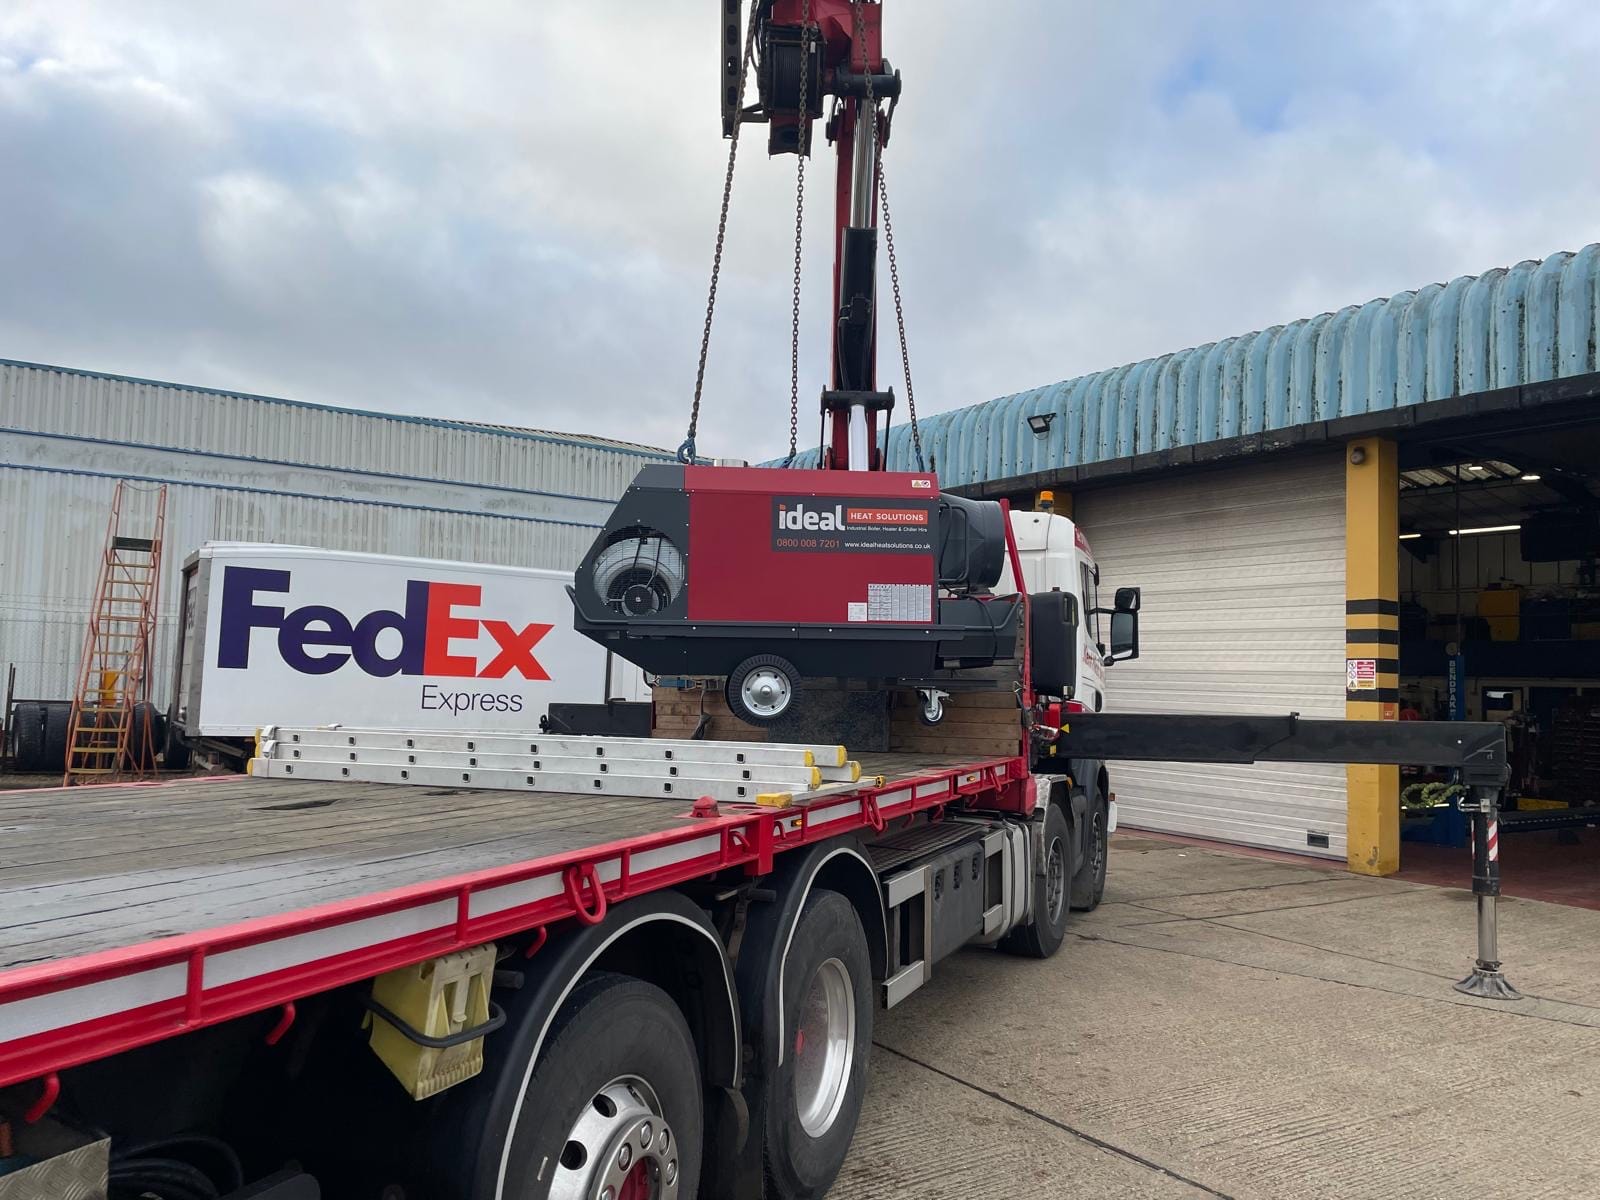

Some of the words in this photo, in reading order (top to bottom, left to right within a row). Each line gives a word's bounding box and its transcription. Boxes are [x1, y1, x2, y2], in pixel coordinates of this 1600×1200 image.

[779, 504, 845, 531] ideal
[876, 513, 924, 521] SOLUTIONS
[776, 538, 799, 548] 0800
[800, 539, 817, 548] 008
[820, 539, 840, 549] 7201
[217, 565, 556, 681] FedEx
[421, 684, 523, 716] Express
